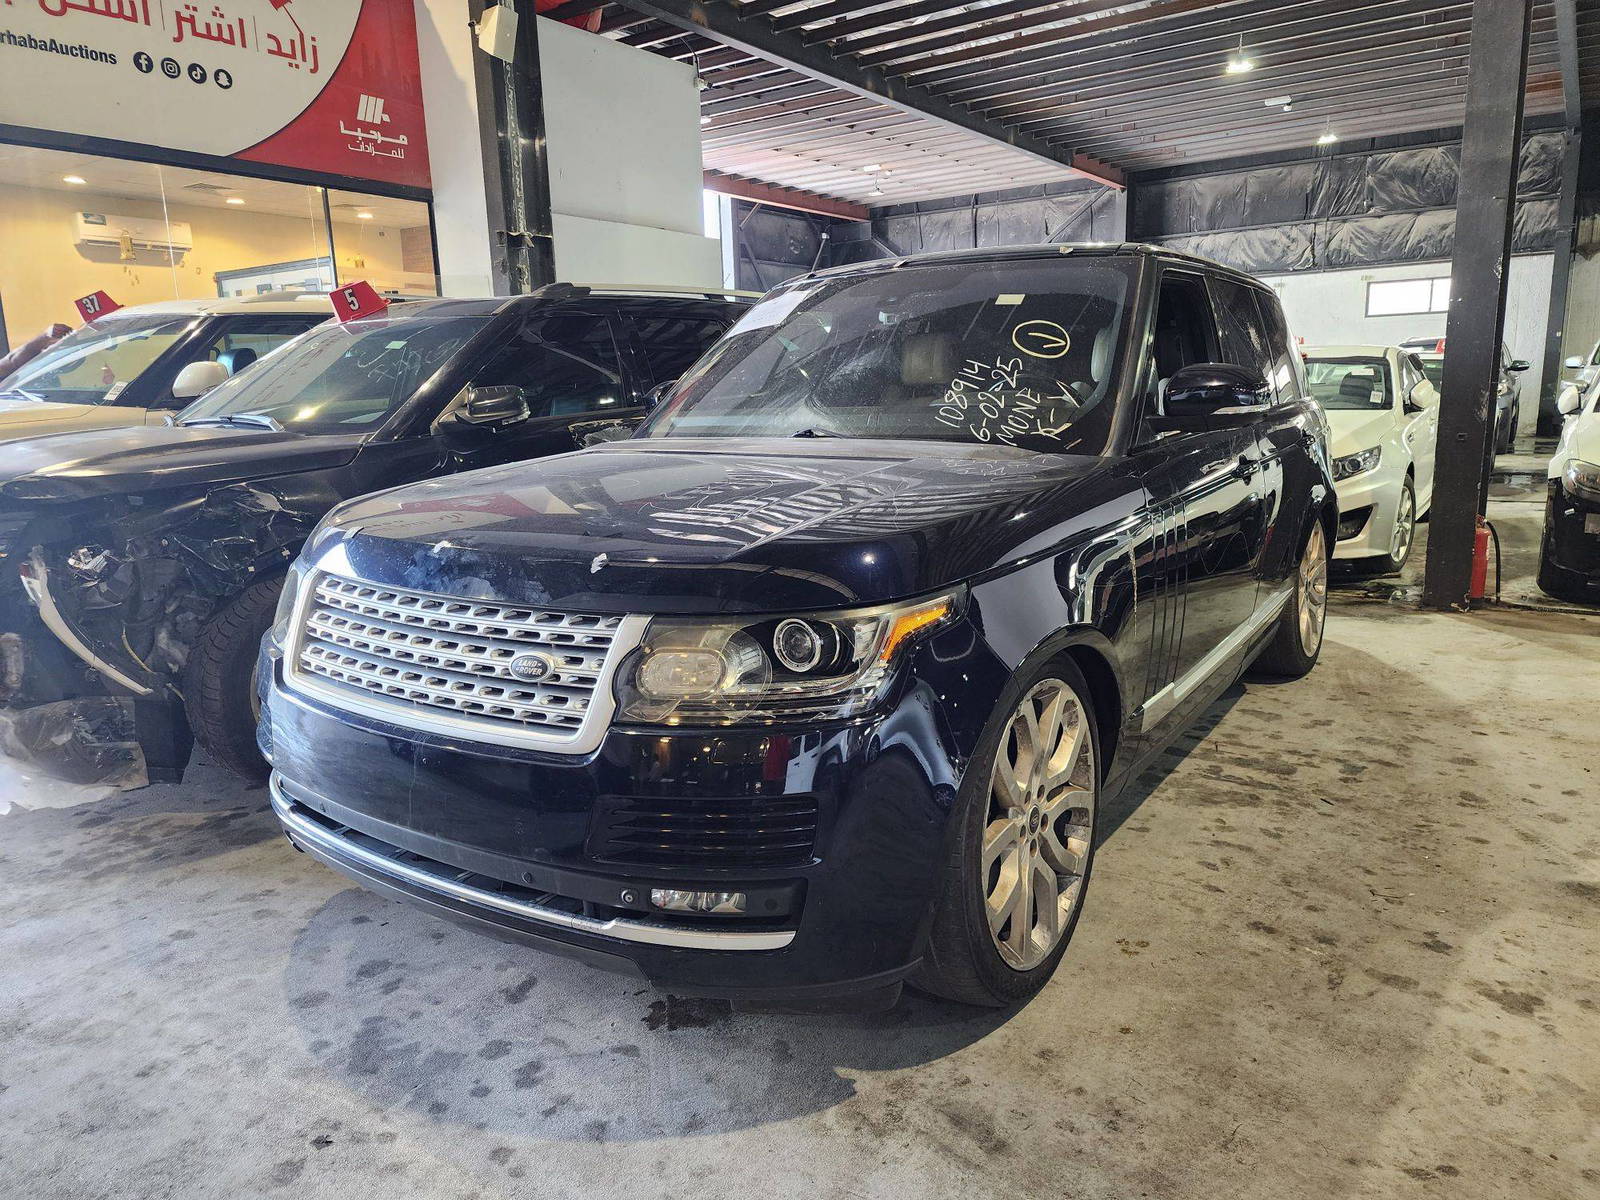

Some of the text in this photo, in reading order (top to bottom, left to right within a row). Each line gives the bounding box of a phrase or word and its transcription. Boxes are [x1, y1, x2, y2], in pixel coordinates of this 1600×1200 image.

[173, 4, 247, 49] اشتر
[267, 31, 319, 74] زايد
[347, 140, 405, 159] للمزادات
[82, 294, 101, 315] 37
[343, 288, 360, 311] 5
[934, 359, 991, 428] 108914
[518, 658, 538, 667] LAND
[518, 666, 543, 676] ROVER
